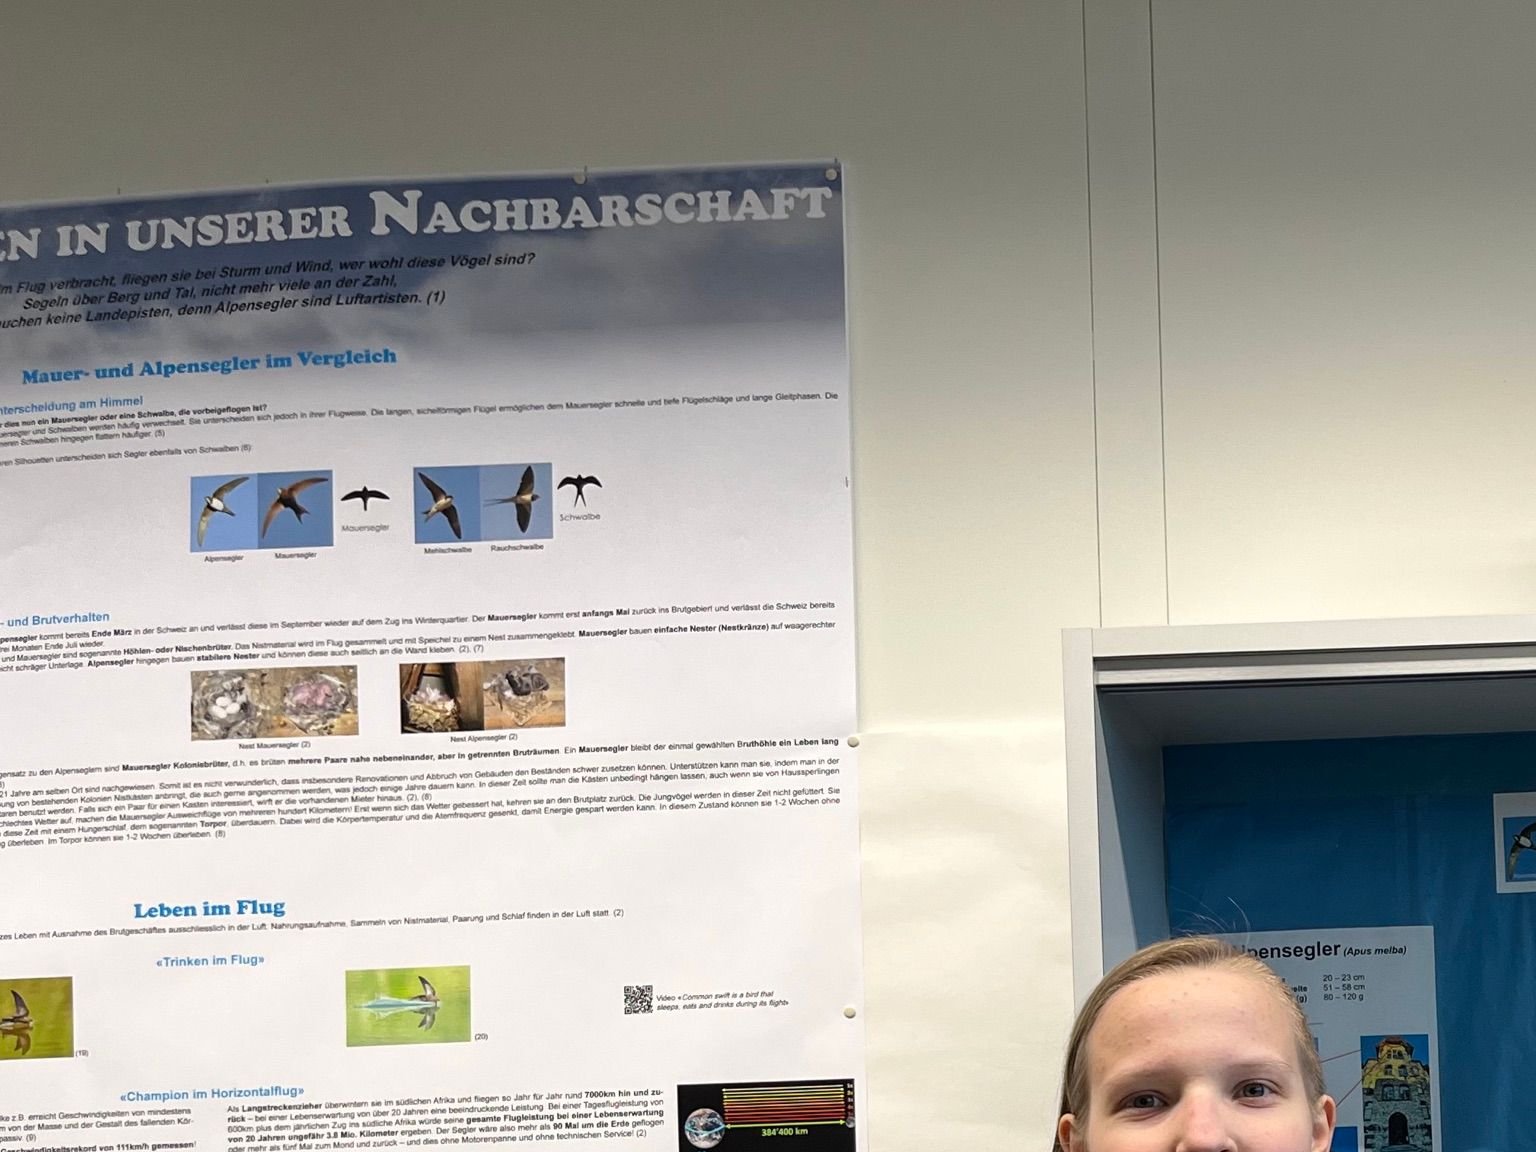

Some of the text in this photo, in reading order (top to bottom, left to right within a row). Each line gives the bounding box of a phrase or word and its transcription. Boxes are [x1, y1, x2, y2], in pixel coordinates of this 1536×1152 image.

[56, 223, 109, 256] IN
[126, 206, 353, 251] UNSERER
[369, 187, 832, 235] NACHBARSCHAFT
[16, 281, 46, 294] Flug
[50, 275, 117, 290] verbracht,
[121, 271, 168, 287] fliegen
[171, 269, 191, 281] sie
[195, 268, 216, 280] bei
[219, 266, 261, 278] Sturm
[264, 262, 291, 275] und
[295, 259, 334, 273] Wind,
[339, 261, 366, 271] wer
[369, 256, 404, 269] wohl
[407, 256, 446, 268] diese
[451, 254, 491, 269] Vögel
[494, 252, 536, 266] sind?
[24, 274, 397, 311] Segeln über Berg und Tal, nicht mehr viele an der Zahl,
[0, 290, 446, 329] uchen keine Landepisten, denn Alpensegler sind Luftartisten. (1)
[22, 348, 398, 385] Mauer- und Alpensegler im Vergleich
[79, 400, 97, 410] am
[100, 396, 144, 408] Himmel
[559, 513, 601, 522] Schwalbe
[341, 524, 390, 533] Mauersegler
[490, 544, 544, 552] Rauchschwalbe
[7, 612, 110, 627] und Brutverhalten
[133, 900, 285, 918] Leben im Flug
[1344, 947, 1372, 957] (Apus
[1374, 945, 1407, 956] melba)
[156, 954, 264, 967] «Trinken im Flug»
[1322, 974, 1333, 982] 20
[1341, 983, 1351, 991] 58
[1323, 993, 1333, 1001] 80
[474, 1032, 489, 1041] (20)
[120, 1086, 304, 1103] «Champion im Horizontalflug»
[761, 1124, 808, 1136] 384'400 km
